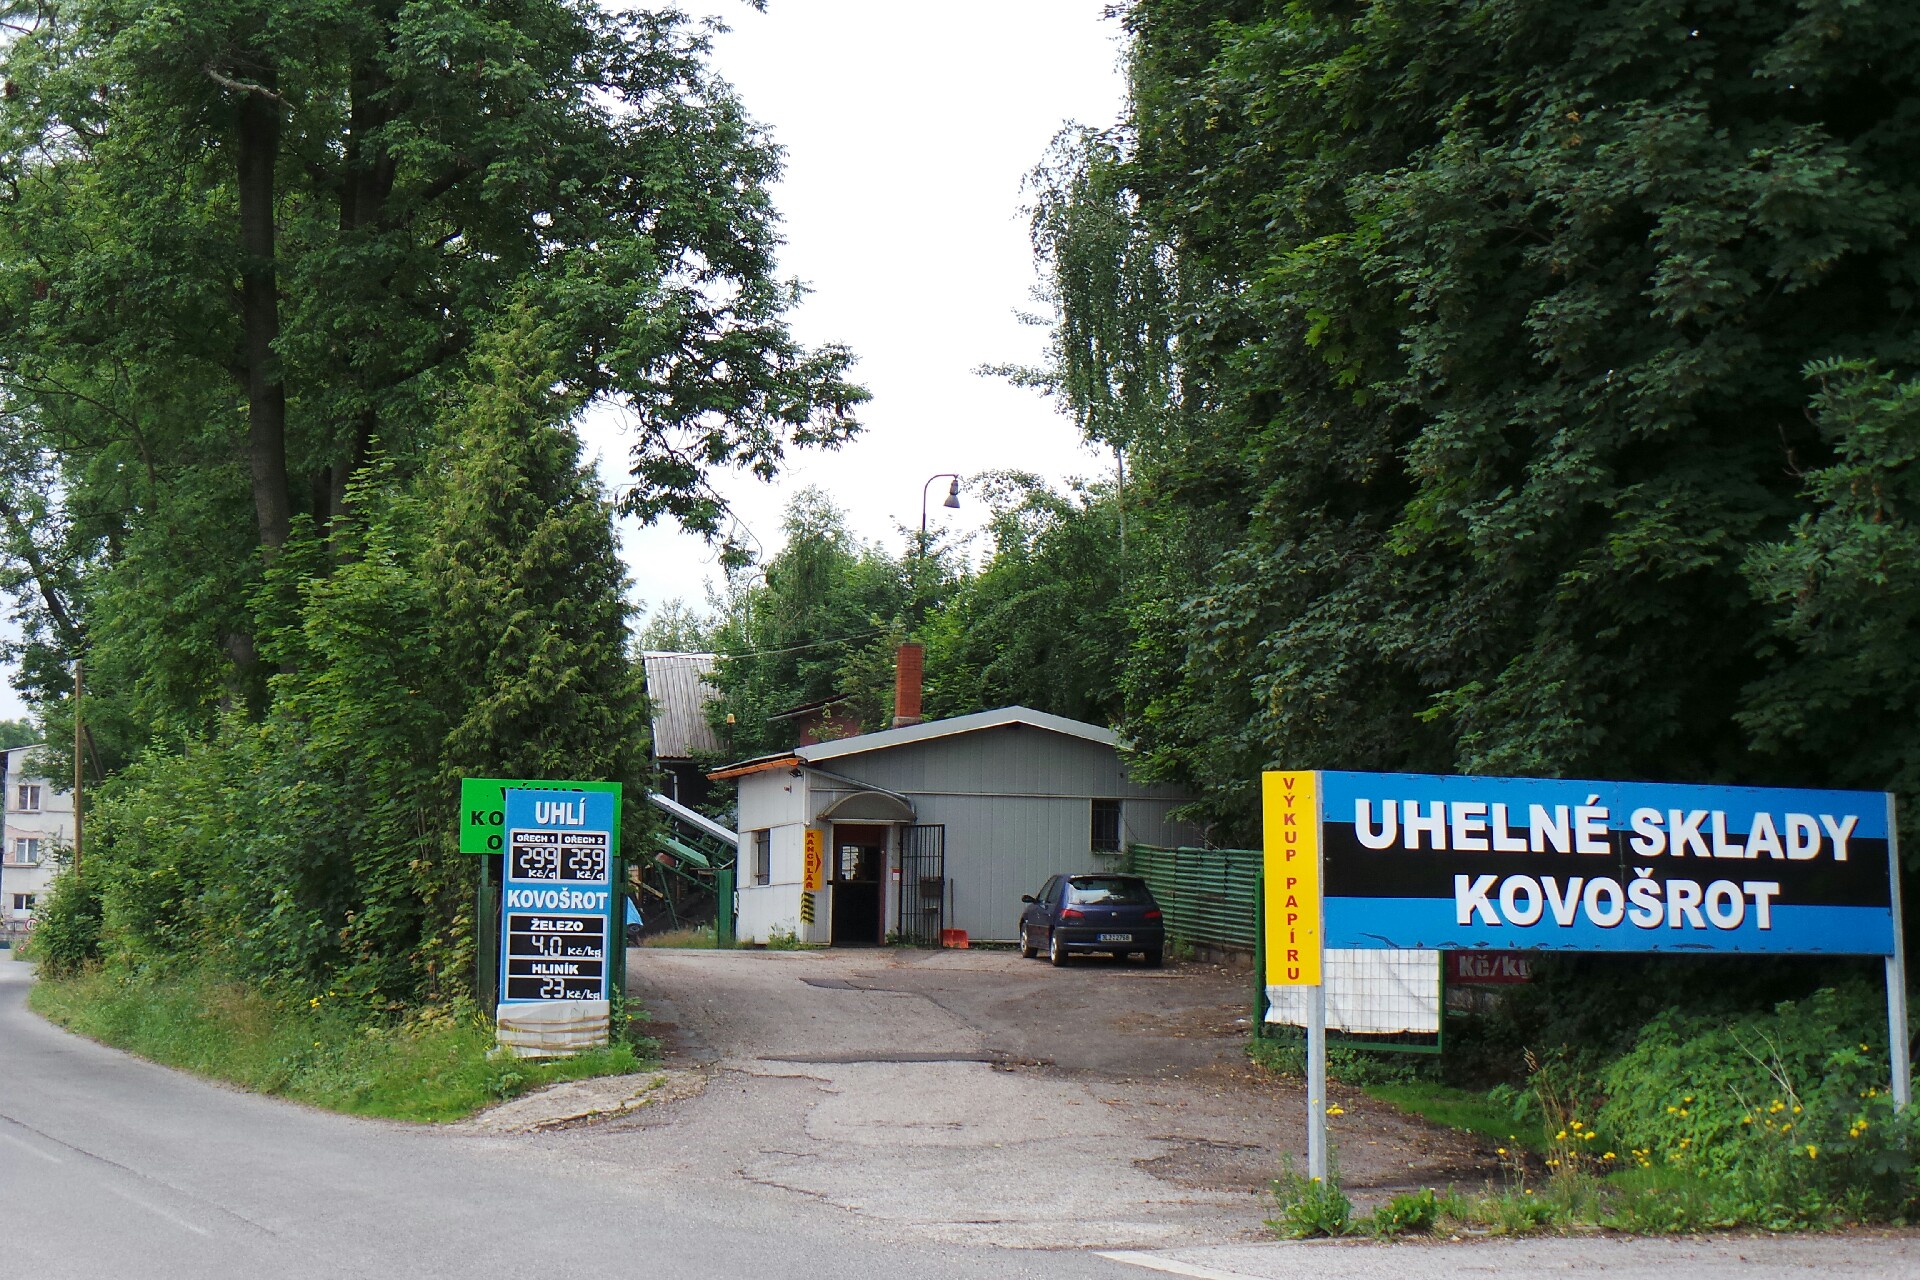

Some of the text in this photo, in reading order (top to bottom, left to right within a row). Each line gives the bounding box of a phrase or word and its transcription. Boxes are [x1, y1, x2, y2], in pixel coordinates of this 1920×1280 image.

[535, 798, 586, 825] UHLÍ
[516, 834, 554, 843] OŘECH 1
[1354, 794, 1860, 862] UHELNÉ SKLADY
[564, 836, 603, 845] OŘECH 2
[519, 848, 557, 869] 299
[568, 849, 604, 870] 259
[1283, 777, 1299, 980] VÝKUP PAPÍRU
[507, 887, 609, 910] KOVOŠROT
[1454, 867, 1780, 930] KOVOŠROT
[530, 918, 584, 932] ŽELEZO
[567, 946, 602, 958] Kč/kg
[532, 962, 579, 975] HLINÍK
[540, 977, 600, 1000] 23 Kč/kg
